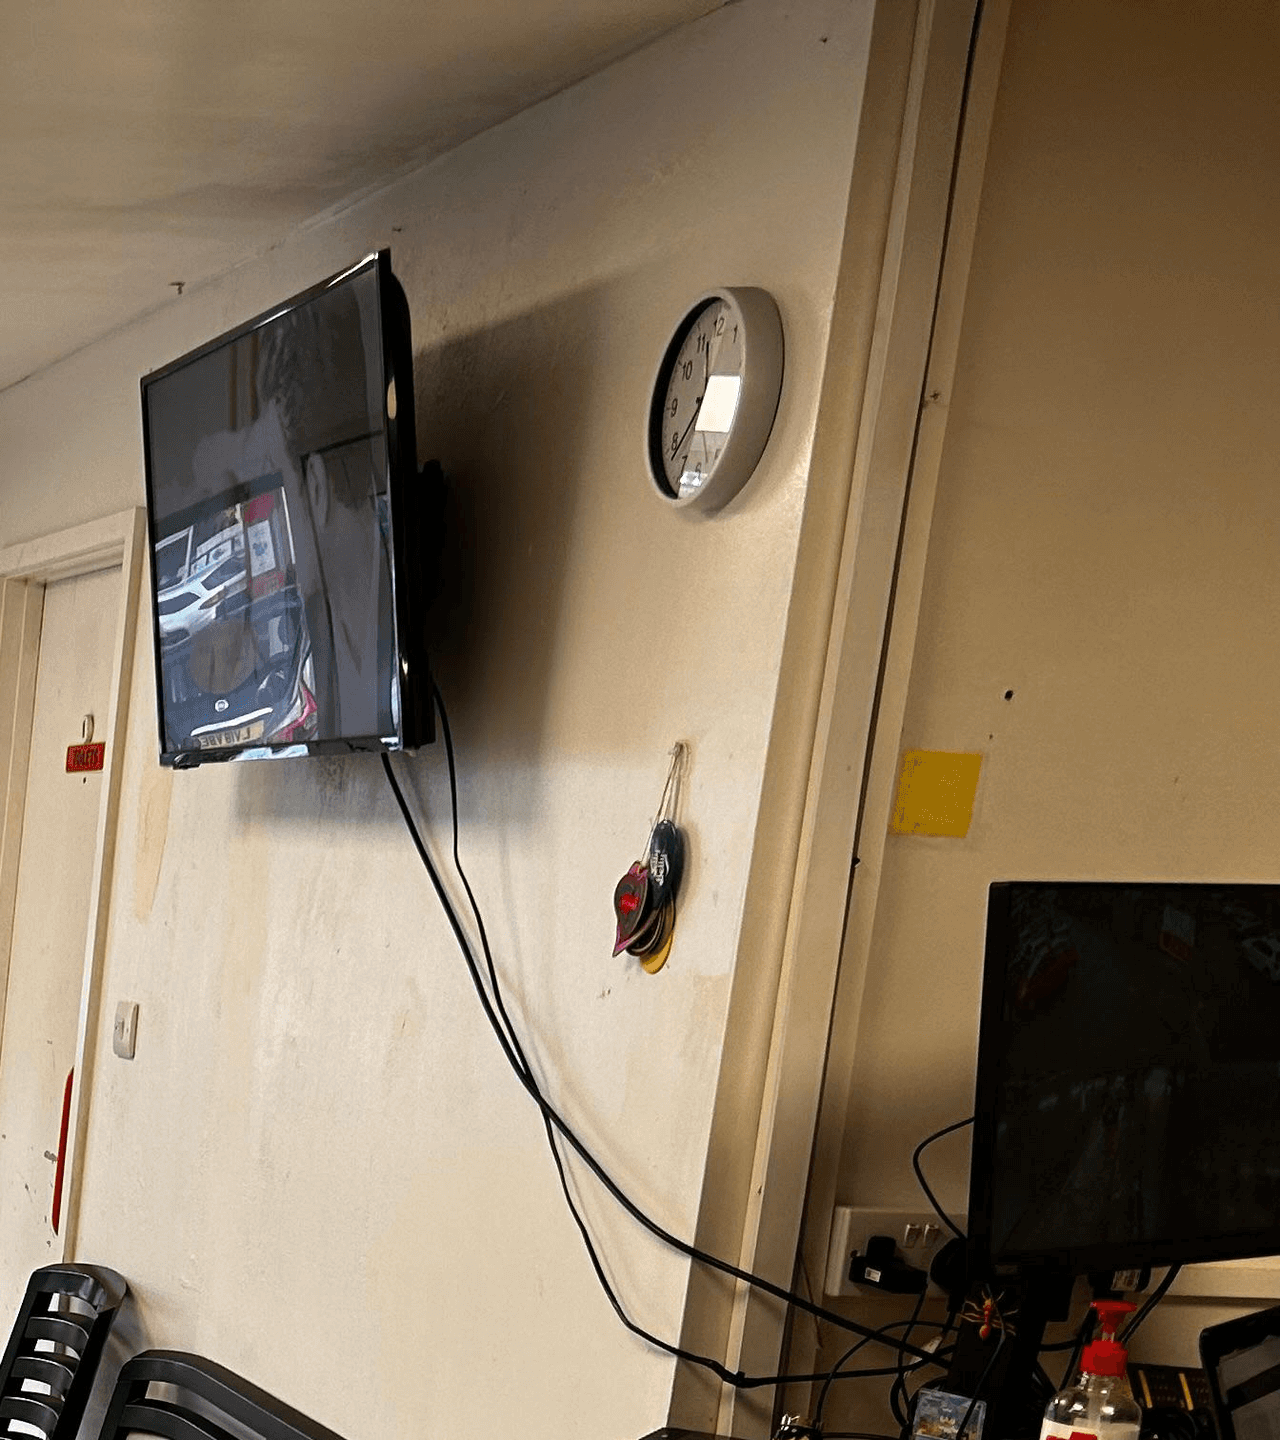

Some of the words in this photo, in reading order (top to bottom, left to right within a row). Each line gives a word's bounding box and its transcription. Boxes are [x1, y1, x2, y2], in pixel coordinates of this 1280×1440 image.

[713, 316, 725, 337] 12
[732, 324, 739, 344] 1
[696, 333, 706, 354] 11
[682, 360, 693, 381] 10
[670, 398, 679, 418] 9
[670, 432, 679, 451] 8
[680, 455, 688, 477] 7
